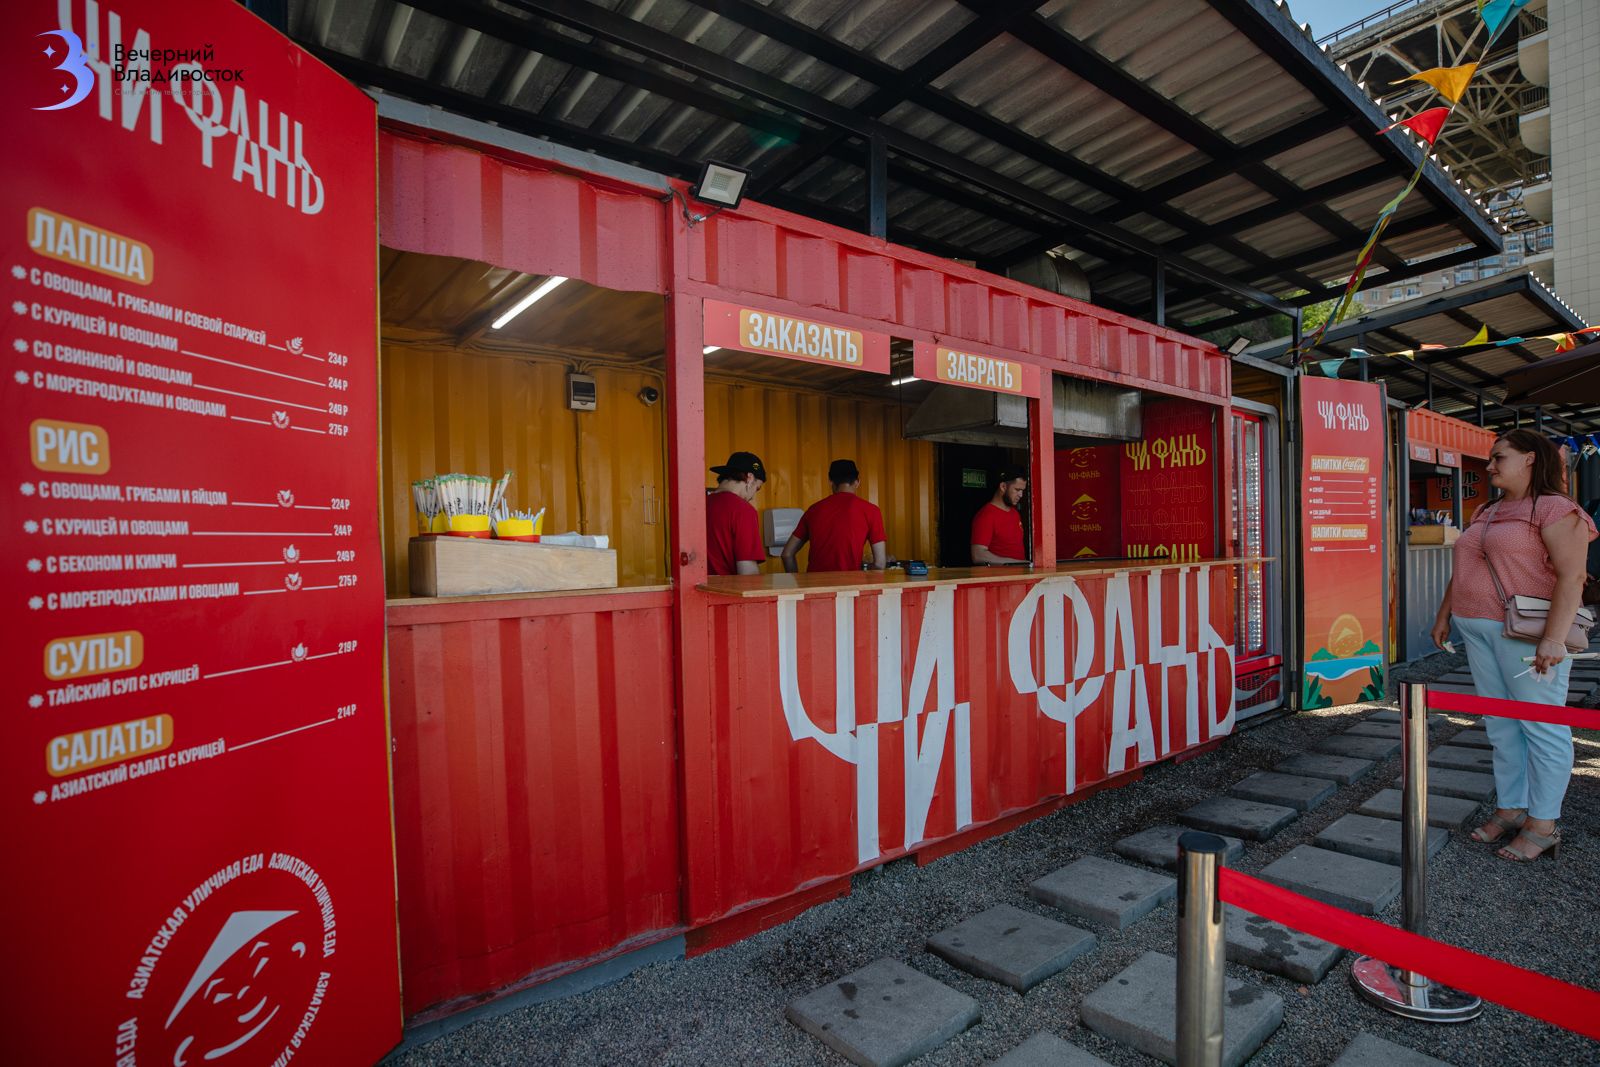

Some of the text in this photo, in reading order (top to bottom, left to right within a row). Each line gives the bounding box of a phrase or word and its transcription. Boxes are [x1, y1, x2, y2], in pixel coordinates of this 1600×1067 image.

[171, 59, 324, 215] ФАНЬ
[30, 211, 146, 280] ЛАПША
[30, 268, 41, 285] С
[43, 271, 116, 307] ОВОЩАМИ,
[117, 292, 173, 322] ГРИБАМИ
[175, 309, 182, 323] И
[184, 311, 222, 334] СОЕВОЙ
[223, 322, 267, 346] СПАРЖЕЙ
[31, 303, 42, 320] С
[44, 306, 107, 336] КУРИЦЕЙ
[108, 322, 118, 338] И
[119, 327, 178, 352] ОВОЩАМИ
[749, 313, 858, 363] ЗАКАЗАТЬ
[33, 340, 52, 361] СО
[54, 344, 125, 374] СВИНИНОЙ
[126, 358, 135, 374] И
[137, 361, 193, 386] ОВОЩАМИ
[947, 352, 1013, 389] ЗАБРАТЬ
[33, 371, 44, 388] С
[46, 373, 164, 409] МОРЕПРОДУКТАМИ
[165, 393, 174, 409] И
[175, 396, 226, 418] ОВОЩАМИ
[1317, 401, 1369, 432] ЧИ ФАНЬ
[36, 426, 99, 467] РИС
[1125, 433, 1207, 471] ЧИ ФАНЬ
[1312, 458, 1341, 470] НАПИТКИ
[38, 482, 49, 498] С
[51, 482, 124, 502] ОВОЩАМИ,
[125, 486, 181, 504] ГРИБАМИ
[182, 489, 190, 504] И
[191, 486, 227, 506] ЯЙЦОМ
[42, 518, 53, 535] С
[55, 517, 118, 537] КУРИЦЕЙ
[120, 520, 129, 535] И
[130, 520, 189, 536] ОВОЩАМИ
[1312, 526, 1341, 538] НАПИТКИ
[46, 556, 57, 573] С
[59, 554, 123, 573] БЕКОНОМ
[124, 554, 134, 570] И
[135, 553, 177, 569] КИМЧИ
[47, 593, 58, 610] С
[60, 585, 178, 610] МОРЕПРОДУКТАМИ
[179, 585, 187, 600] И
[188, 582, 240, 600] ОВОЩАМИ
[49, 635, 132, 677] СУПЫ
[47, 679, 111, 706] ТАЙСКИЙ
[112, 676, 137, 695] СУП
[139, 675, 148, 689] С
[150, 664, 199, 688] КУРИЦЕЙ
[776, 565, 1235, 864] ЧИ ФАНЬ
[50, 717, 163, 772] САЛАТЫ
[51, 763, 128, 802] АЗИАТСКИЙ
[129, 757, 166, 779] САЛАТ
[168, 753, 177, 768] С
[178, 738, 225, 766] КУРИЦЕЙ
[126, 853, 264, 999] АЗИАТСКАЯ УЛИЧНАЯ ЕДА
[268, 852, 336, 958] АЗИАТСКАЯ УЛИЧНАЯ ЕДА
[290, 971, 331, 1049] АЗИАТСКАЯ
[116, 1017, 138, 1056] ЕДА
